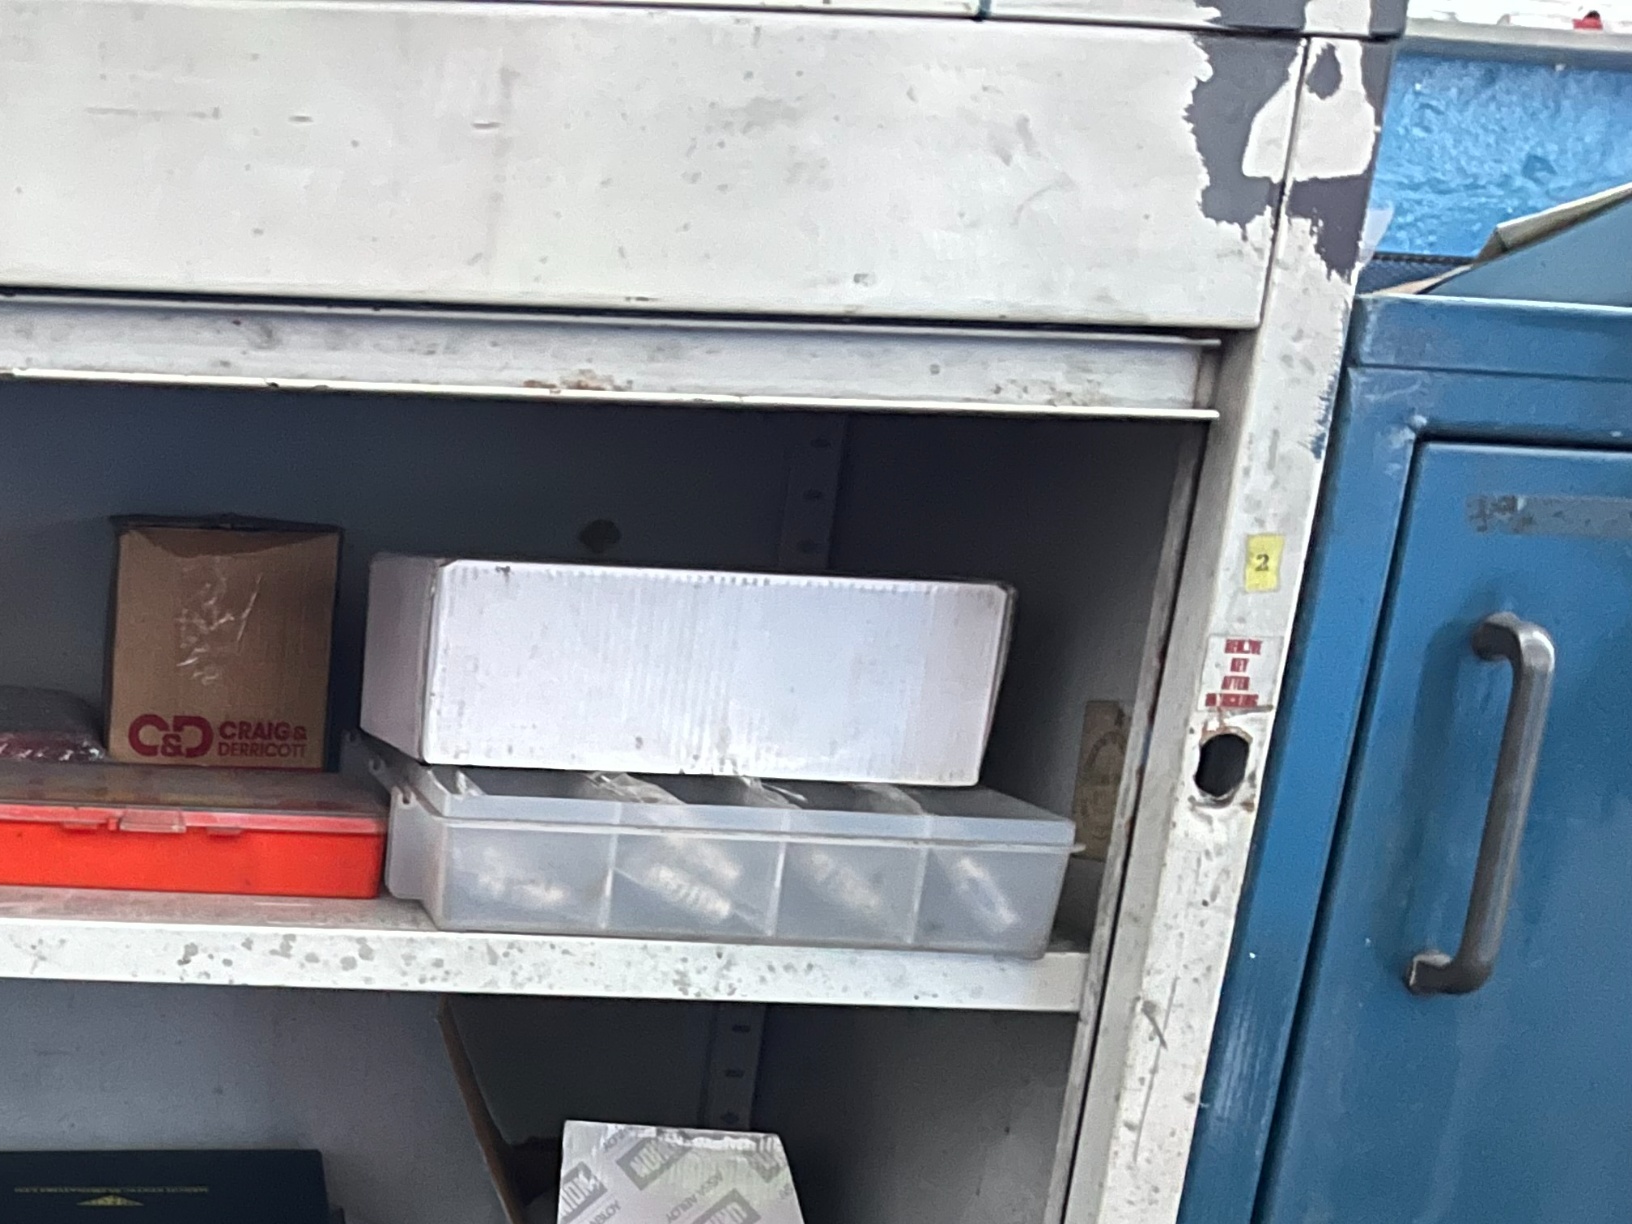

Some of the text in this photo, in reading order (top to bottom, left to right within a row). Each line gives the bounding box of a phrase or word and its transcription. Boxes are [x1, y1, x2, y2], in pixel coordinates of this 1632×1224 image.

[1255, 554, 1269, 572] 2
[219, 711, 308, 740] CRAIG &
[218, 742, 308, 758] DERRICOTT
